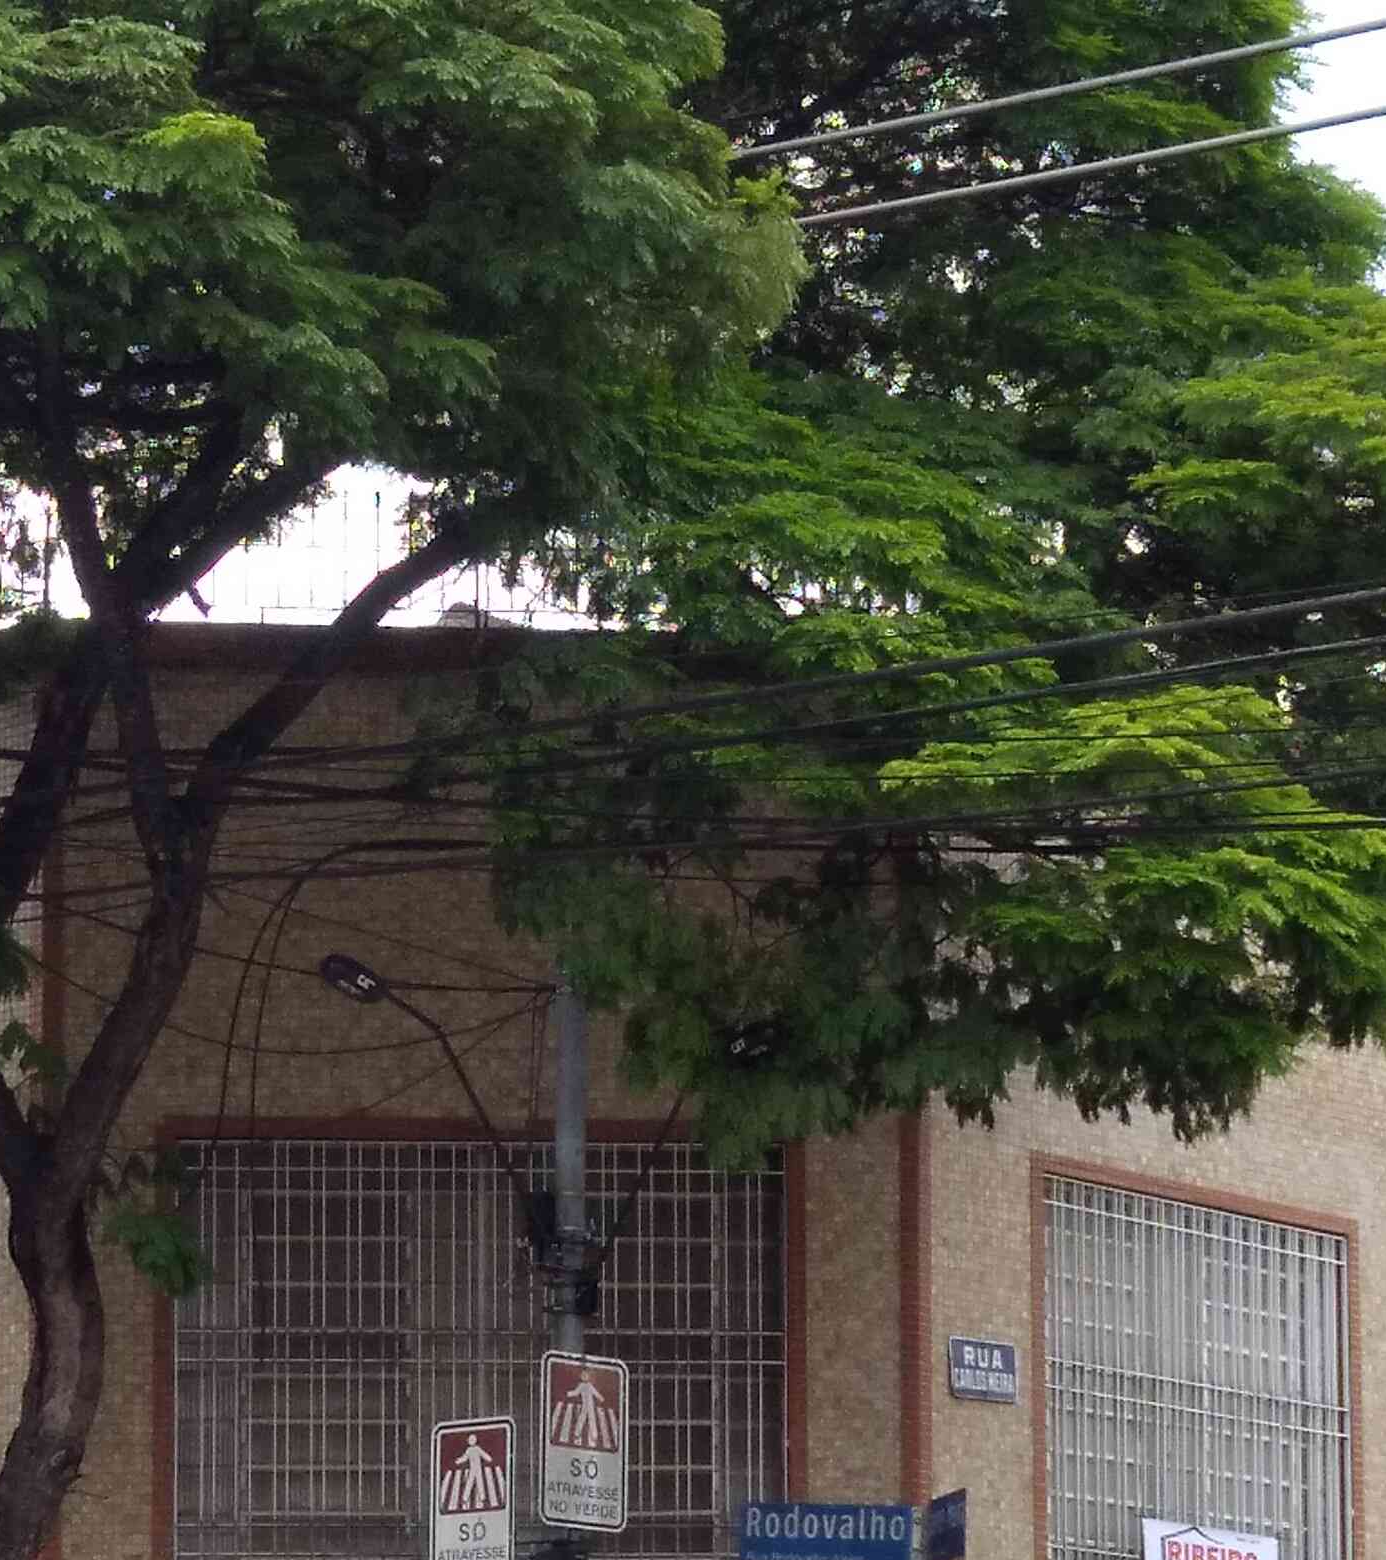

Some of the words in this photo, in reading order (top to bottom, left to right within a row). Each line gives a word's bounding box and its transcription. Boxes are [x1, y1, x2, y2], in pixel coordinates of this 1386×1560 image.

[964, 1346, 1003, 1369] RUA
[569, 1455, 598, 1479] SÓ
[547, 1480, 619, 1502] ATRAVESSE
[549, 1500, 568, 1515] NO
[575, 1502, 618, 1521] VERDE
[458, 1517, 487, 1542] SÓ
[745, 1505, 906, 1541] Rodovalho
